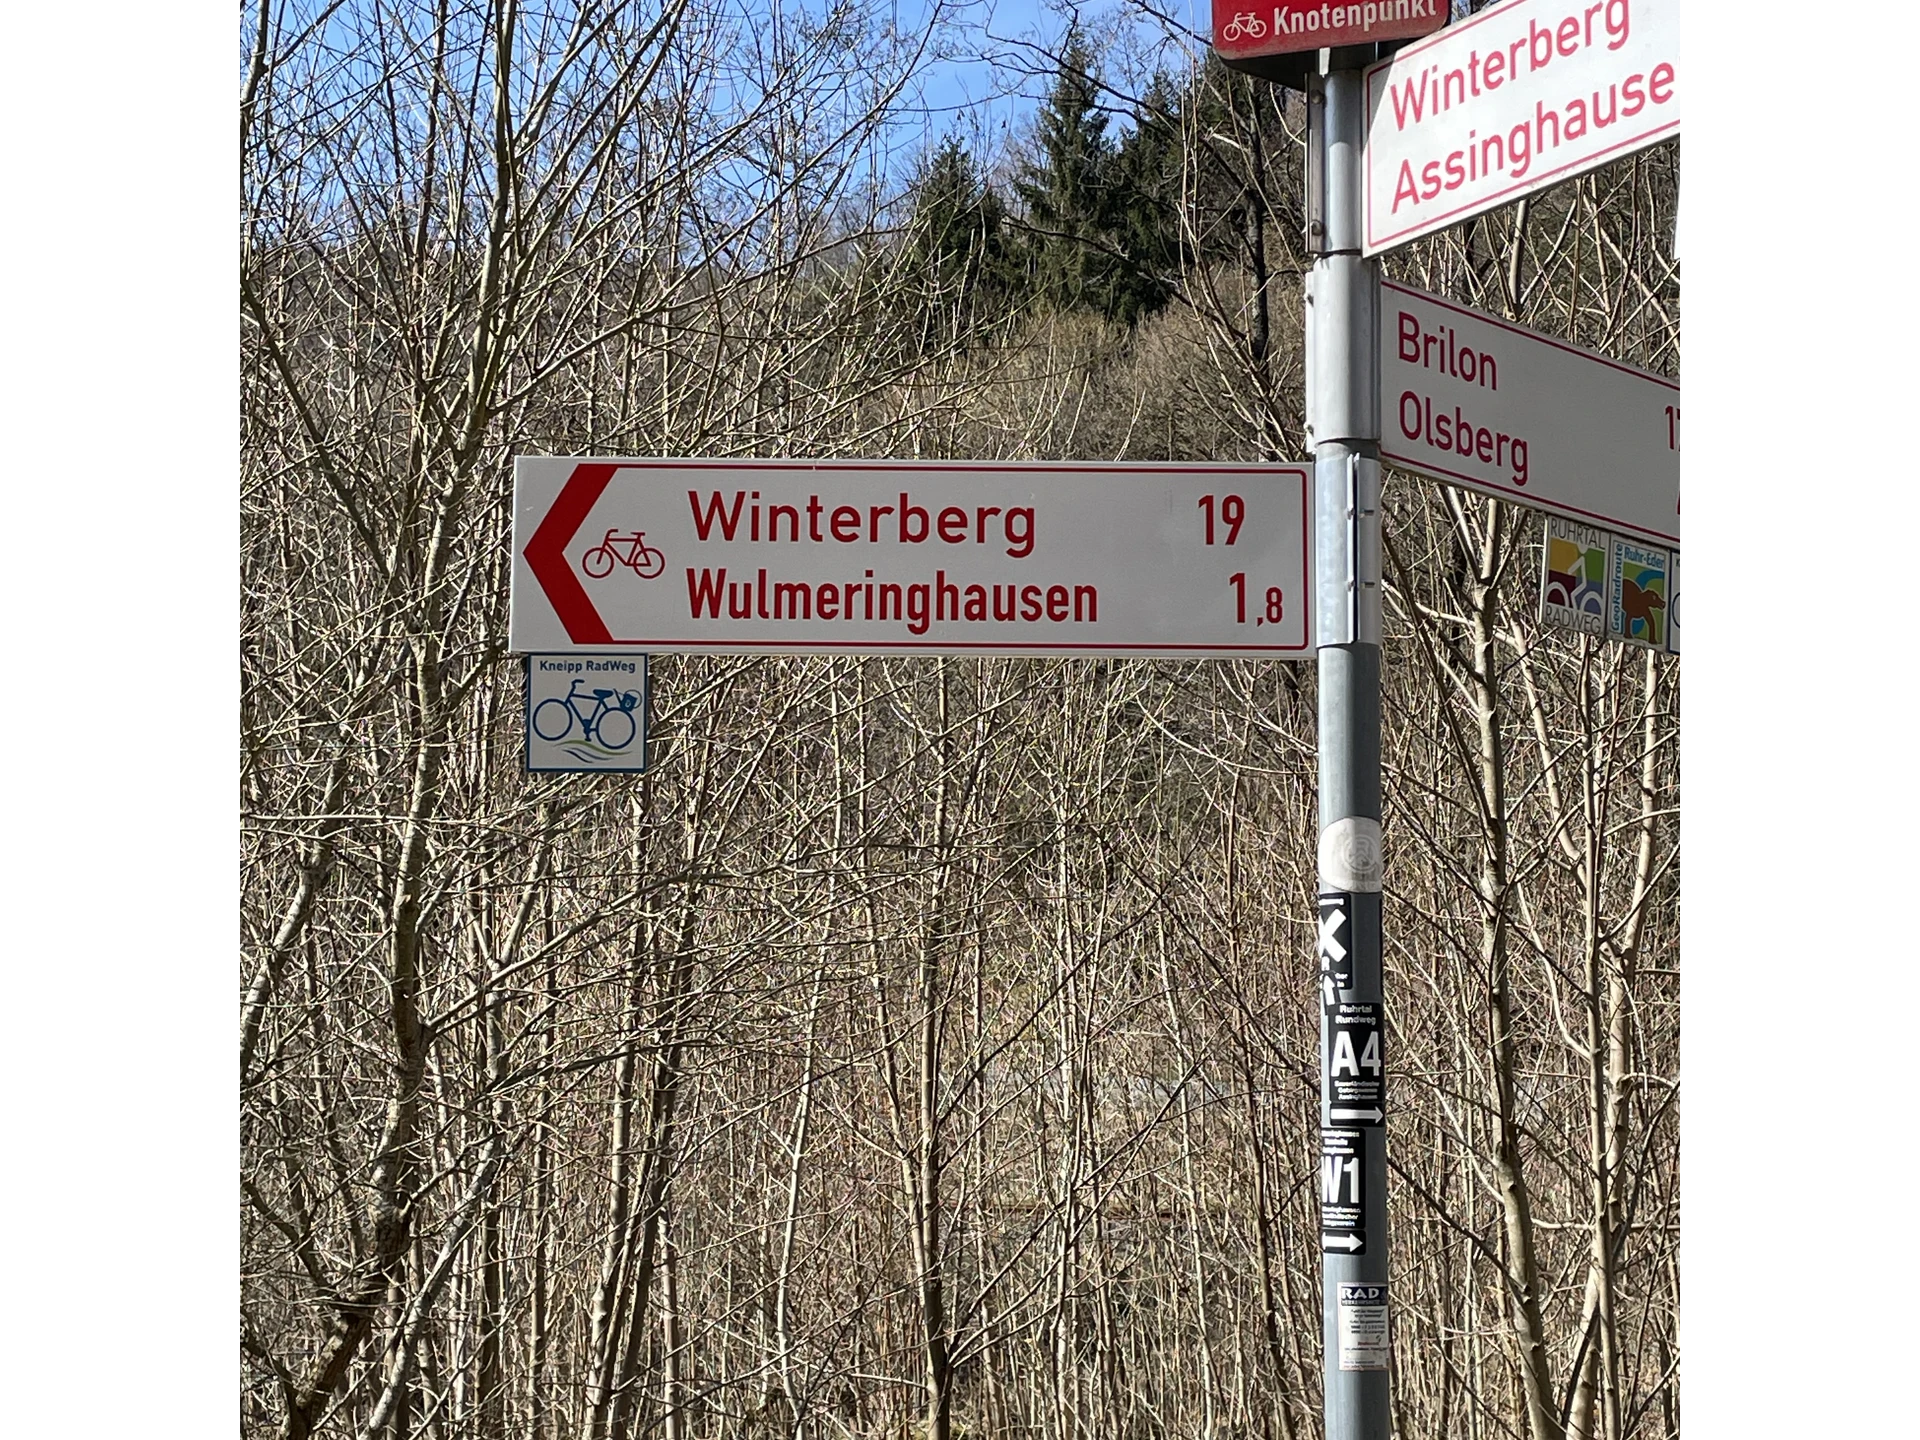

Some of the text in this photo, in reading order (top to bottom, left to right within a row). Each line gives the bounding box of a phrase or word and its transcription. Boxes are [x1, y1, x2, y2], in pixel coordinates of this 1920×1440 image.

[1273, 0, 1437, 36] Knotenpunkt
[1390, 0, 1629, 132] Winterberg
[1391, 62, 1676, 215] Assinghause
[1398, 311, 1498, 391] Brilon
[1399, 391, 1529, 486] Olsberg
[688, 491, 1245, 559] Winterberg 19
[1550, 518, 1606, 551] RUHRTAL
[1624, 546, 1665, 571] Ruhr-Eder
[686, 568, 1284, 636] Wulmeringhausen 1,8
[1611, 543, 1624, 632] GeoRadroute
[1545, 604, 1600, 636] RADWEG
[540, 660, 636, 674] Kneipp RadWeg
[1335, 1014, 1377, 1026] Rundweg
[1330, 1031, 1382, 1078] A4
[1320, 1155, 1360, 1204] W1
[1341, 1287, 1380, 1300] RAD
